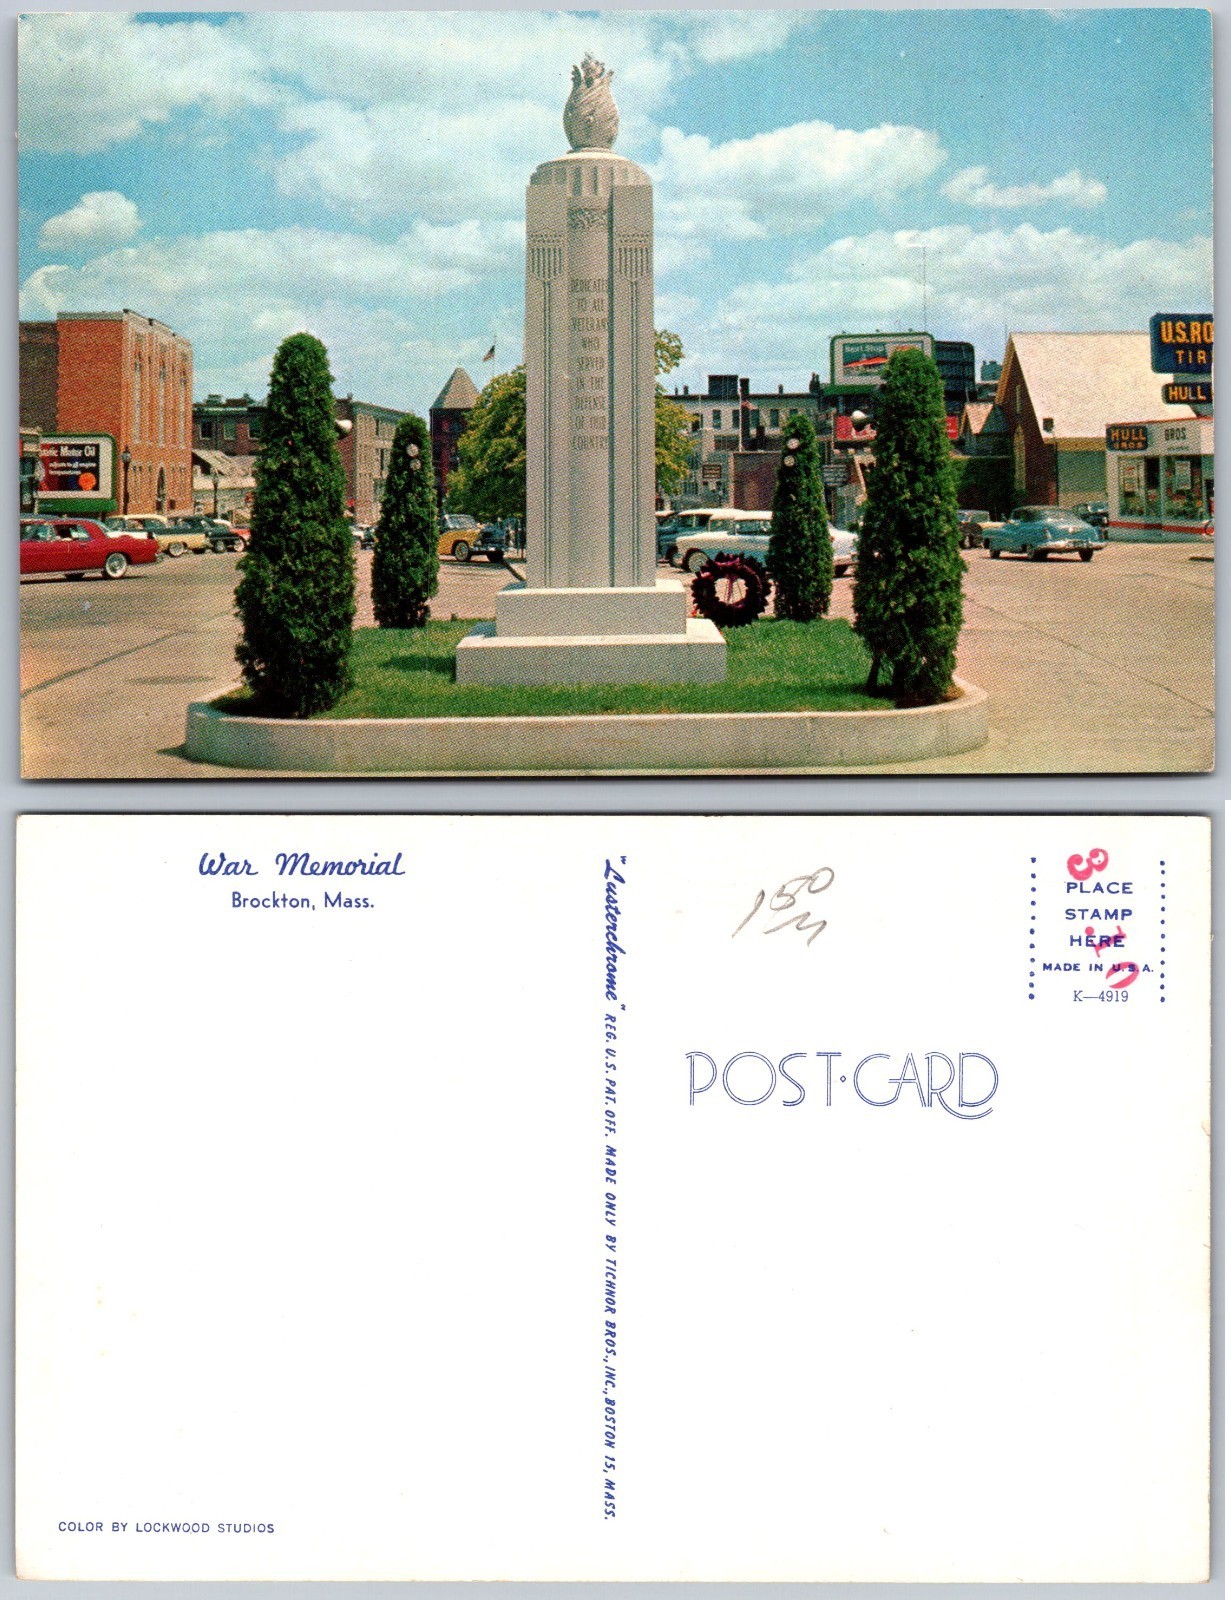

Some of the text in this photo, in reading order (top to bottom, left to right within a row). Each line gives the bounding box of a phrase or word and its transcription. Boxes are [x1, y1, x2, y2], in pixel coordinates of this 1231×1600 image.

[593, 298, 604, 312] ALL
[581, 337, 600, 350] WHO
[1176, 349, 1213, 365] TIR
[591, 377, 604, 390] THE
[1168, 386, 1207, 401] HULL
[1110, 426, 1187, 441] HULL BROS
[60, 445, 83, 457] Motor
[84, 445, 96, 457] Oil
[198, 851, 406, 877] War Memorial
[1066, 881, 1133, 894] PLACE
[231, 890, 375, 911] Brockton, Mass.
[1064, 908, 1133, 921] STAMP
[1069, 934, 1125, 948] HERE
[1042, 962, 1155, 973] MADE IN U.S.A.
[604, 1013, 617, 1043] REG.
[604, 1047, 617, 1074] U.S.
[604, 1077, 617, 1105] PAT.
[604, 1109, 617, 1137] OFF.
[604, 1144, 617, 1185] MADE
[604, 1192, 617, 1227] ONLY
[605, 1234, 617, 1252] BY
[604, 1258, 617, 1315] TICHNOR
[604, 1396, 617, 1449] BOSTON
[602, 1455, 617, 1473] 15,
[603, 1478, 617, 1520] MASS.
[58, 1521, 275, 1533] COLOR BY LOCKWOOD STUDIOS
